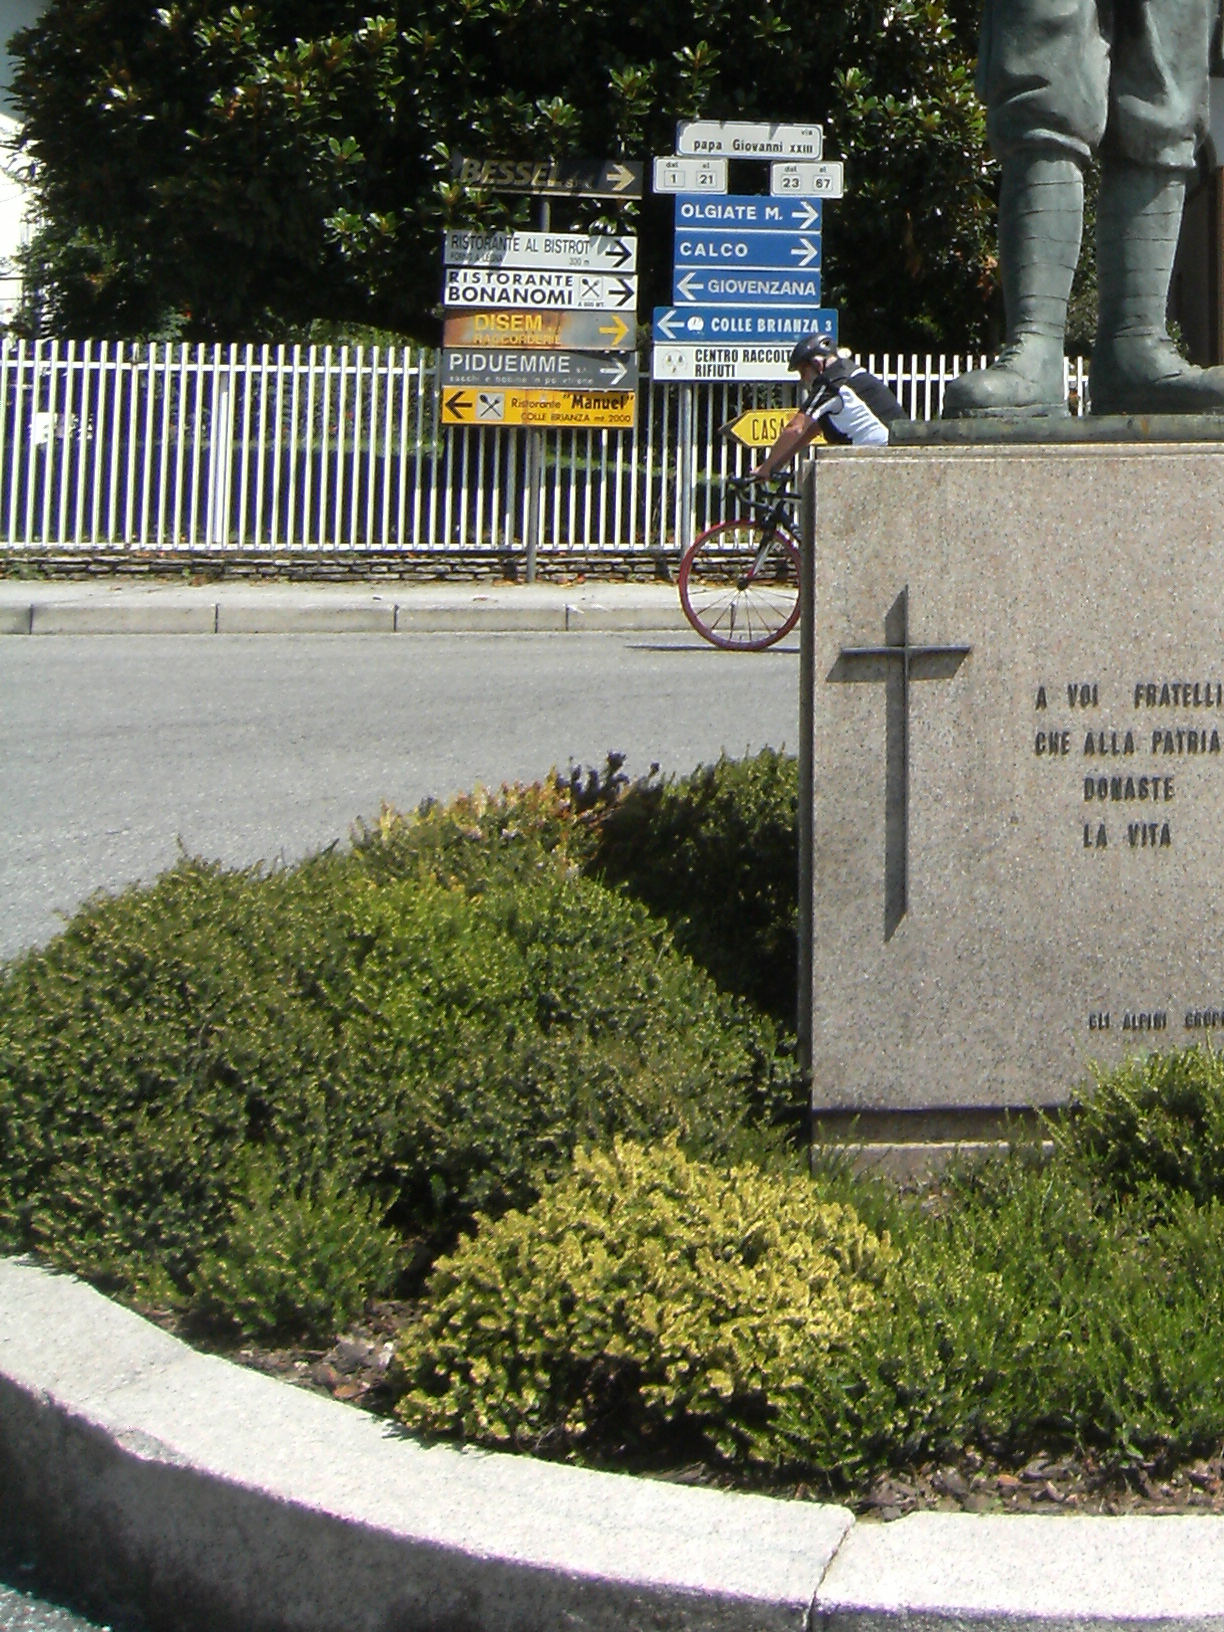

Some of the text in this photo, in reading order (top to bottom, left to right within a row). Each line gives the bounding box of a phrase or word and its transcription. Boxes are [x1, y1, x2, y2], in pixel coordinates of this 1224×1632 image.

[693, 139, 722, 152] papa
[733, 139, 783, 153] Giovanni
[460, 158, 562, 187] BESSEL
[671, 174, 713, 184] 1 21
[783, 177, 831, 189] 23 67
[681, 203, 783, 220] OLGIATE M.
[451, 234, 590, 254] RISTORANTE AL BISTROT
[680, 241, 748, 257] CALCO
[449, 271, 573, 287] RISTORANTE
[708, 279, 816, 296] GIOVENZANA
[449, 286, 573, 305] BONANOMI
[474, 314, 543, 332] DISEM
[711, 317, 833, 333] COLLE BRIANZA 3
[449, 354, 571, 373] PIDUEMME
[695, 349, 791, 363] CENTRO RACCOLT
[695, 364, 736, 378] RIFIUTI
[511, 398, 562, 409] Ristorante
[521, 413, 546, 421] COLLE
[551, 413, 590, 422] BRIANZA
[609, 414, 631, 423] 2000
[1035, 682, 1223, 710] A VOI FRATELLI
[1035, 728, 1221, 756] CHE ALLA PATRIA
[1083, 776, 1175, 802] DONASTE
[1083, 822, 1172, 848] LA VITA
[1089, 1011, 1111, 1030] GLI
[1122, 1011, 1167, 1030] ALPINI
